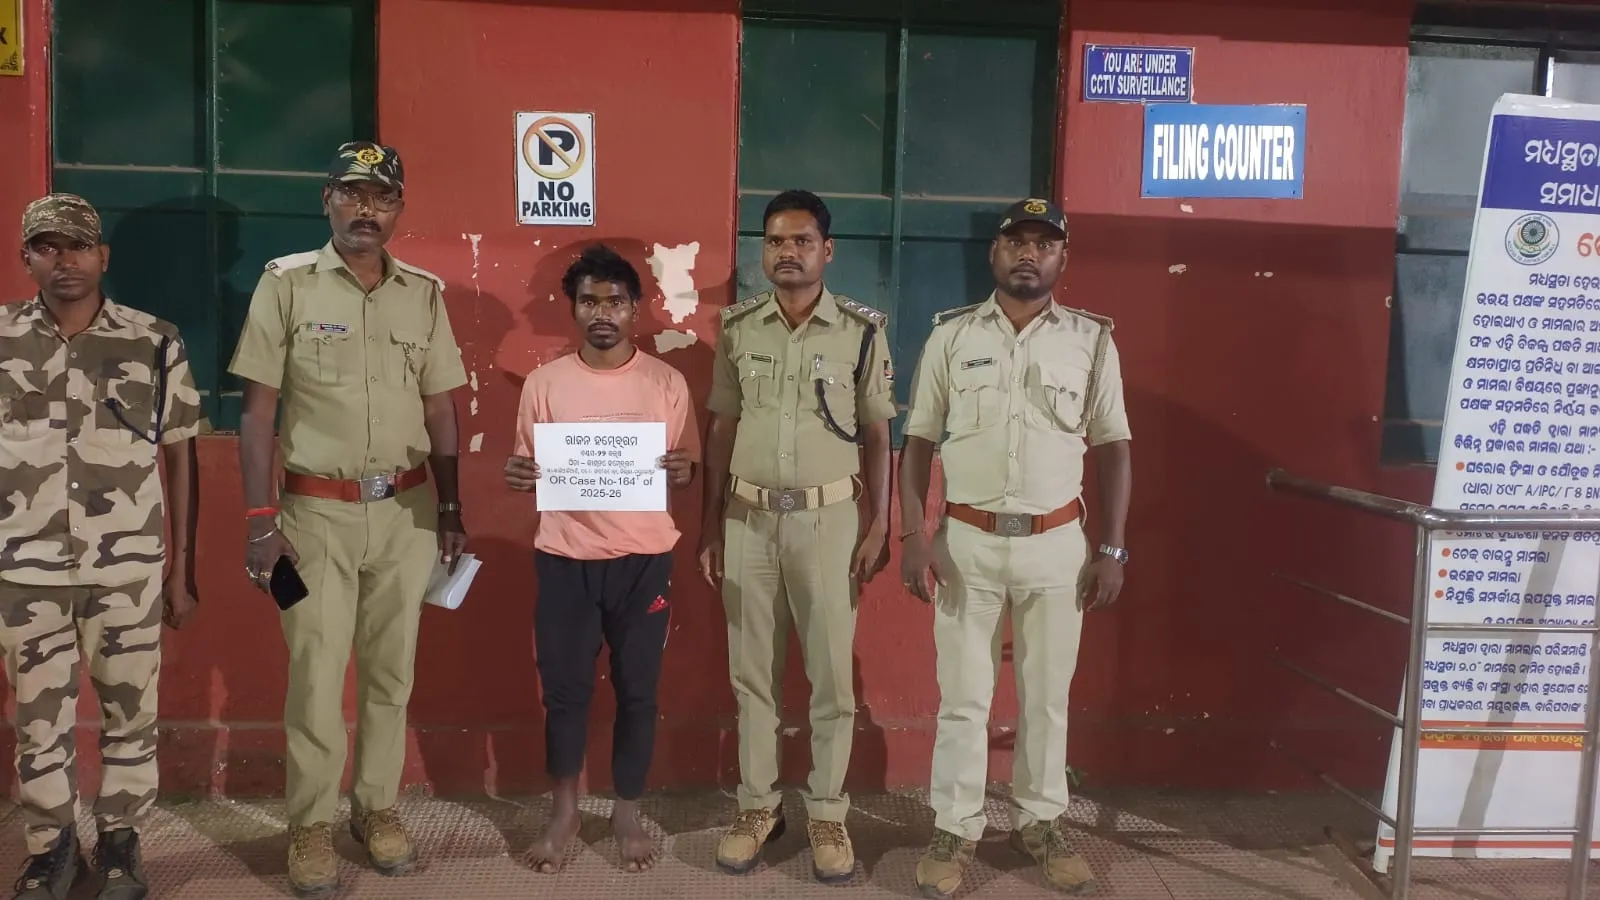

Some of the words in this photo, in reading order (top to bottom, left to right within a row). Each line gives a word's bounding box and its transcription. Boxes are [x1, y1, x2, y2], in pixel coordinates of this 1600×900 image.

[1103, 52, 1121, 73] YOU
[1124, 53, 1143, 74] ARE
[1145, 53, 1176, 74] UNDER
[1090, 74, 1116, 95] CCTV
[1117, 75, 1187, 96] SURVEILLANCE
[1152, 123, 1209, 181] FILING
[1213, 123, 1295, 181] COUNTER
[538, 181, 575, 201] NO
[522, 201, 591, 217] PARKING
[1528, 317, 1538, 328] ଓ
[1567, 362, 1579, 374] ବା
[1463, 378, 1473, 389] ଓ
[1537, 465, 1547, 476] ଓ
[549, 475, 566, 485] OR
[569, 475, 596, 486] Case
[643, 476, 653, 486] of
[580, 488, 622, 498] 2025-26
